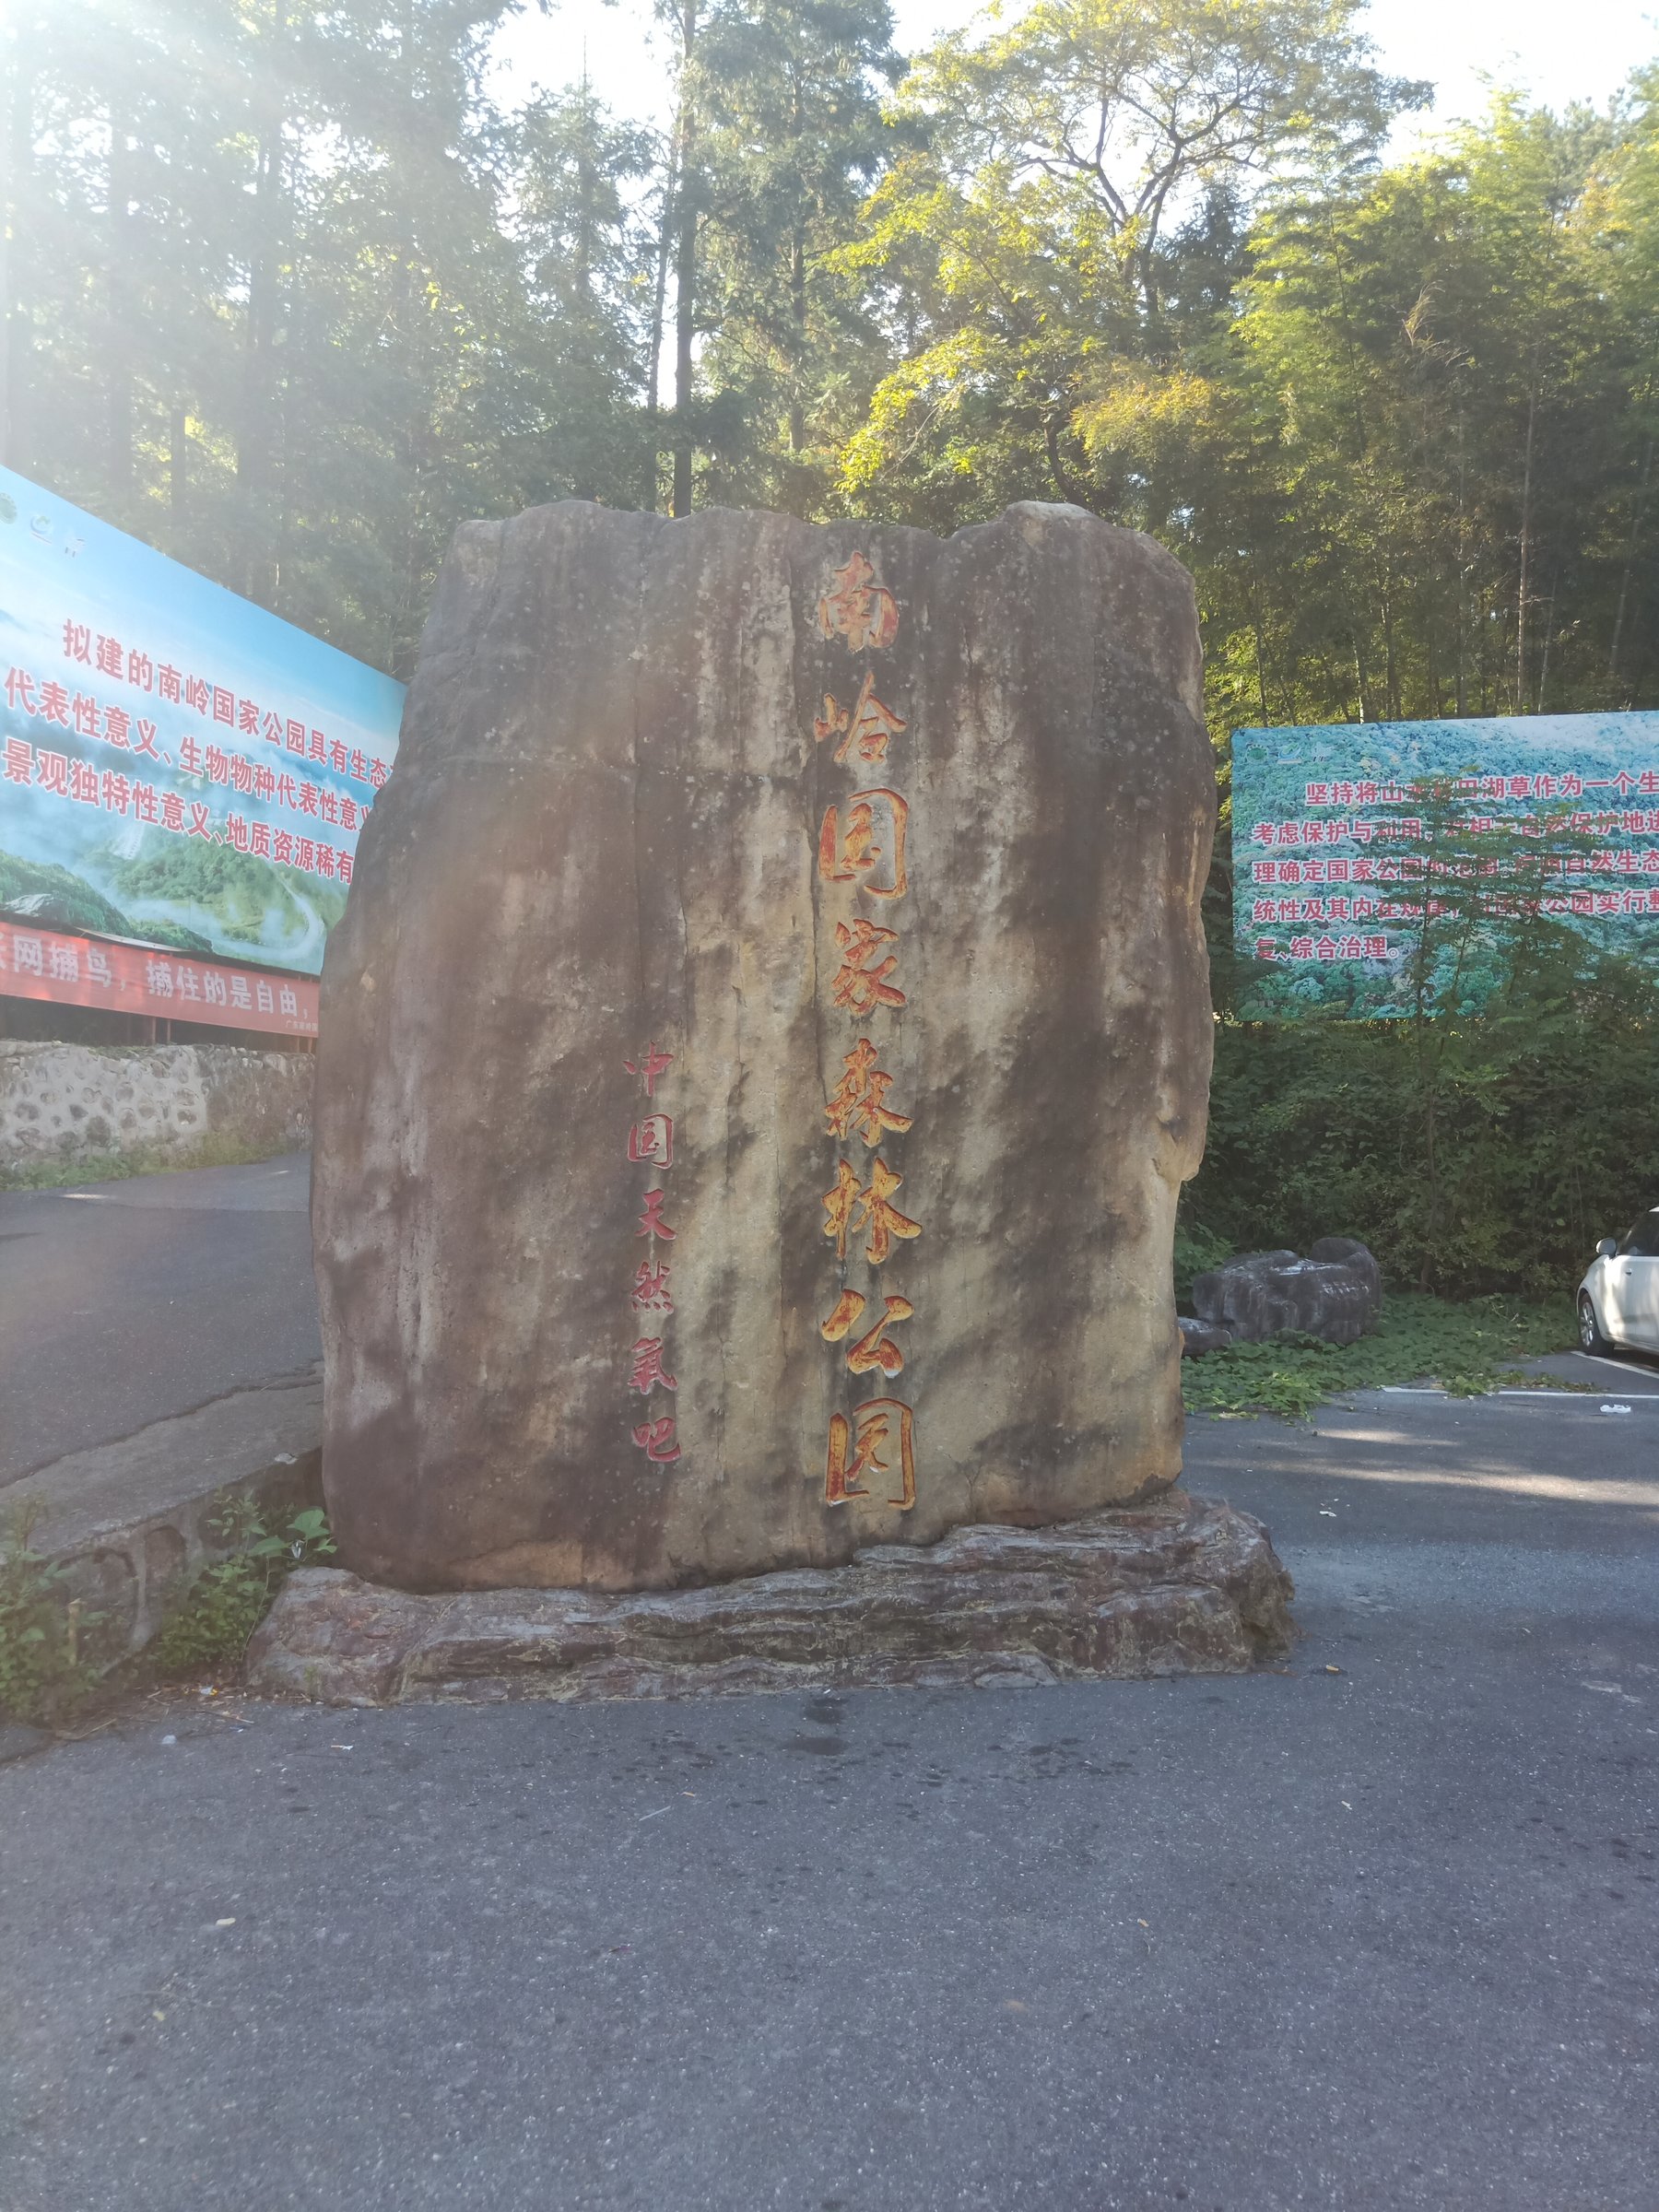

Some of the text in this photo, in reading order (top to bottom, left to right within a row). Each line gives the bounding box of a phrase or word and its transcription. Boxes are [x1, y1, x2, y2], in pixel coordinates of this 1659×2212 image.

[63, 619, 394, 790] 拟建的南岭国家公园具有生态
